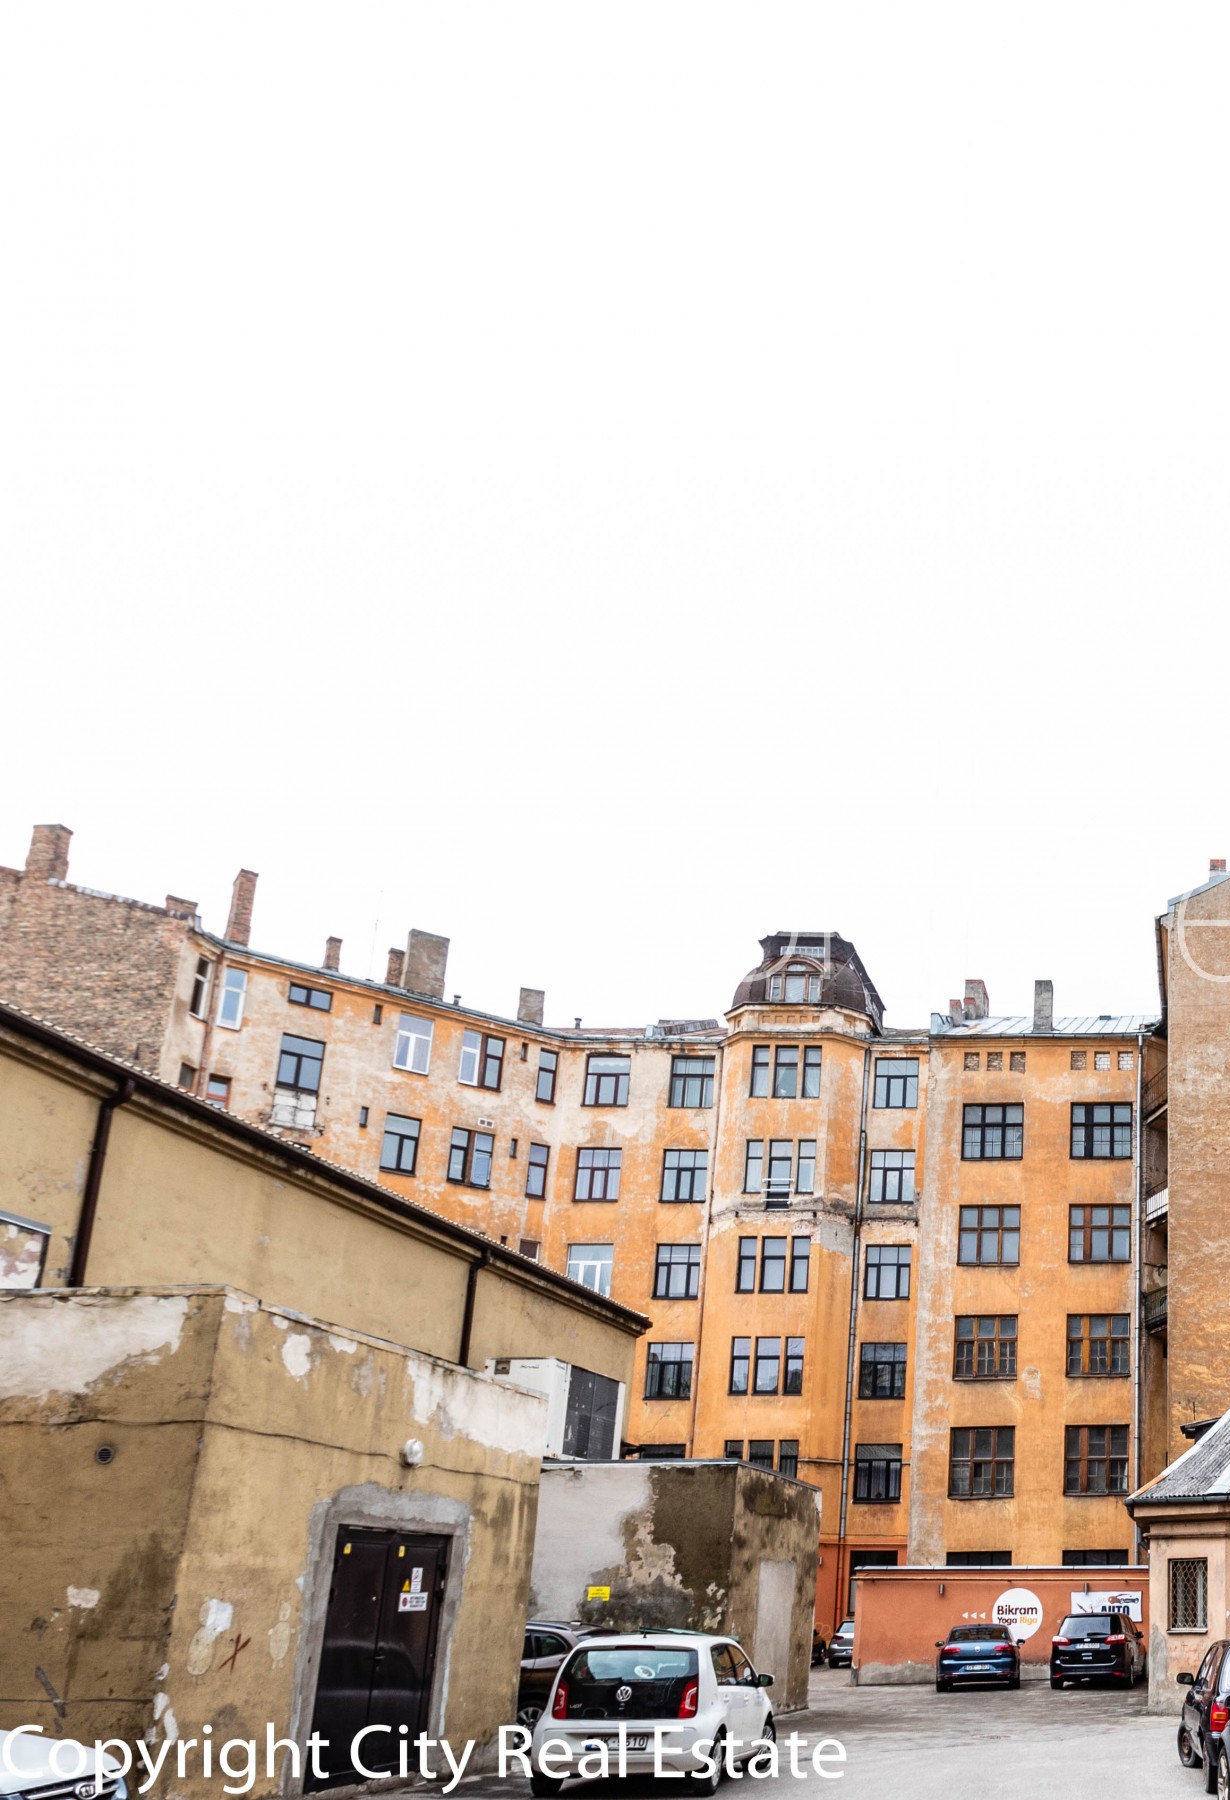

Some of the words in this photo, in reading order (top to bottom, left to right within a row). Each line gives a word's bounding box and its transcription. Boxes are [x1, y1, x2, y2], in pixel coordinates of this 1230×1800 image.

[997, 1604, 1038, 1615] Bikram
[997, 1617, 1017, 1625] Yoga
[1019, 1617, 1038, 1625] Riga
